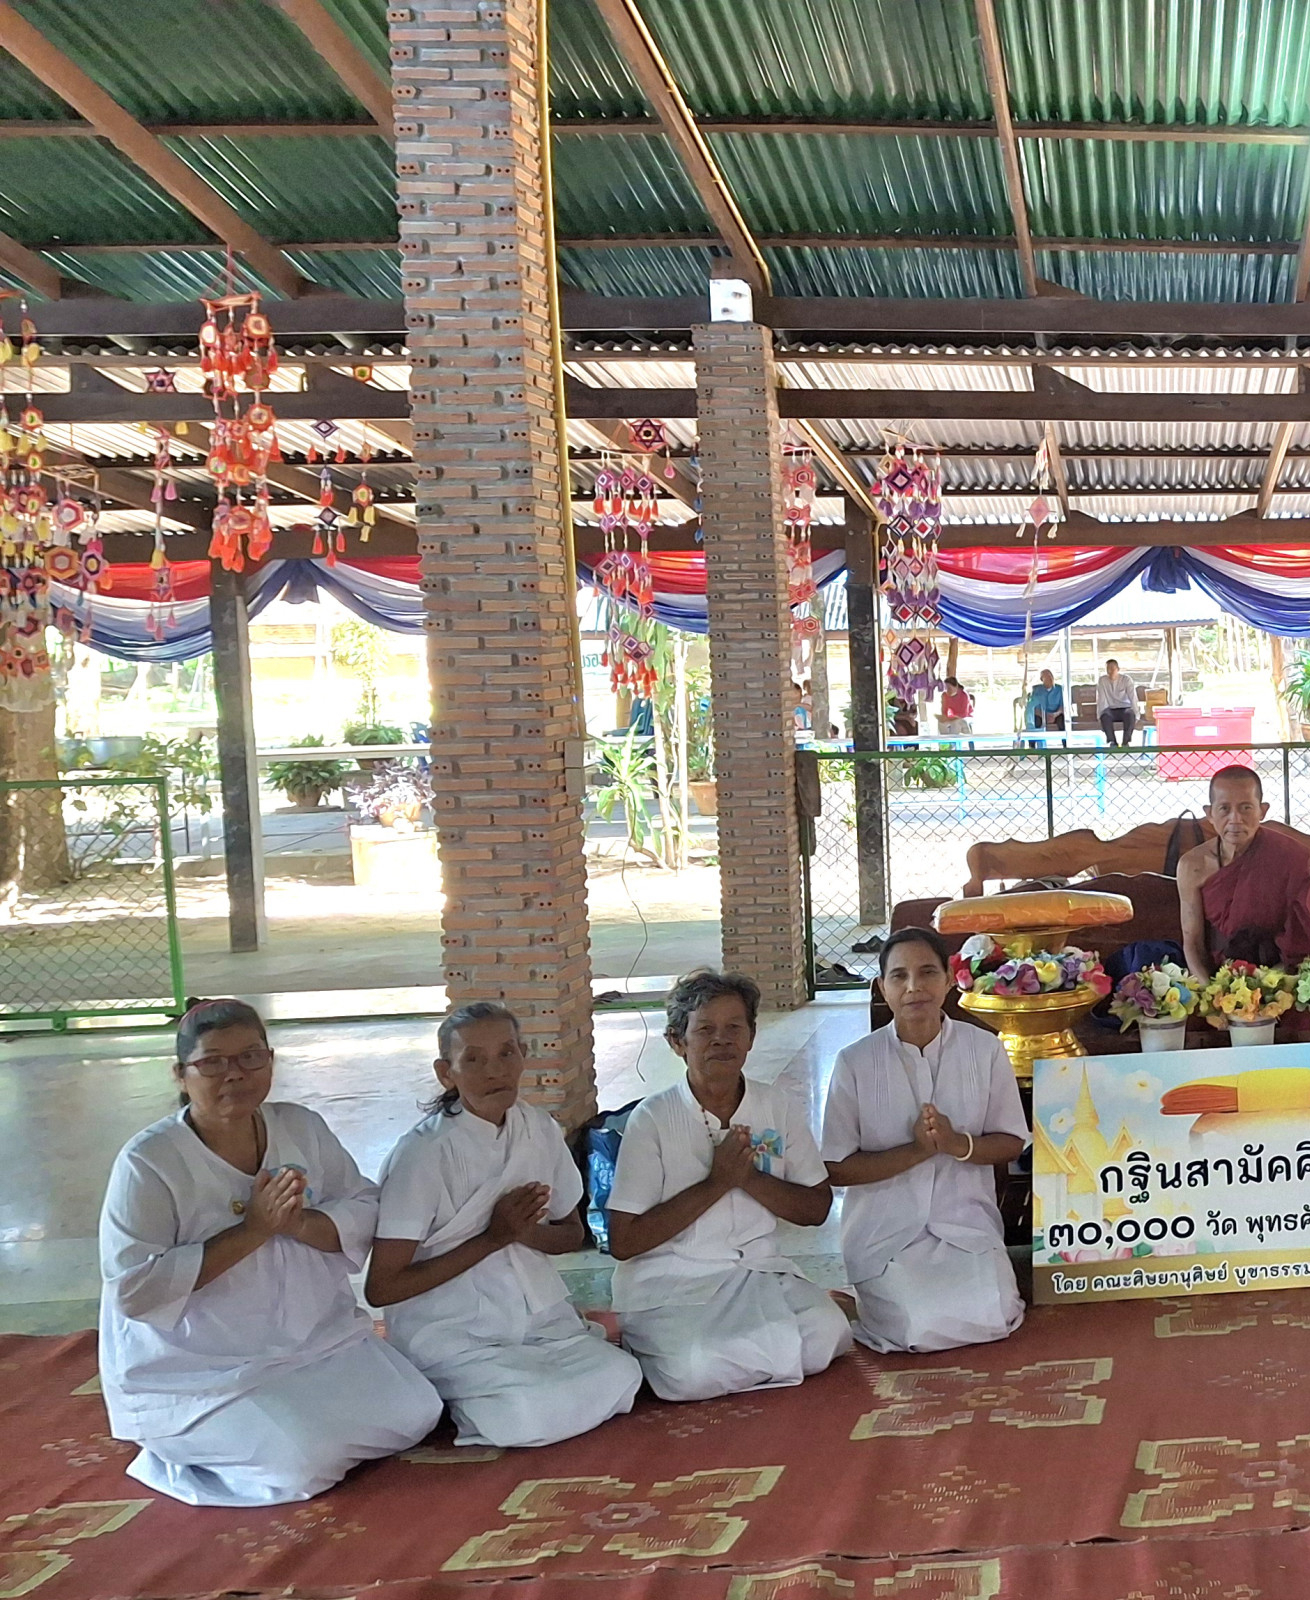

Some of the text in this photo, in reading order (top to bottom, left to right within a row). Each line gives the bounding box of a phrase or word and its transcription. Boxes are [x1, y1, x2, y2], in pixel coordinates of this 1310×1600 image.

[1050, 1215, 1195, 1249] ๓๐,๐๐๐
[1206, 1210, 1238, 1236] วัด
[1053, 1275, 1086, 1292] โดย
[1093, 1262, 1228, 1289] คณะศิษยานุศิษย์
